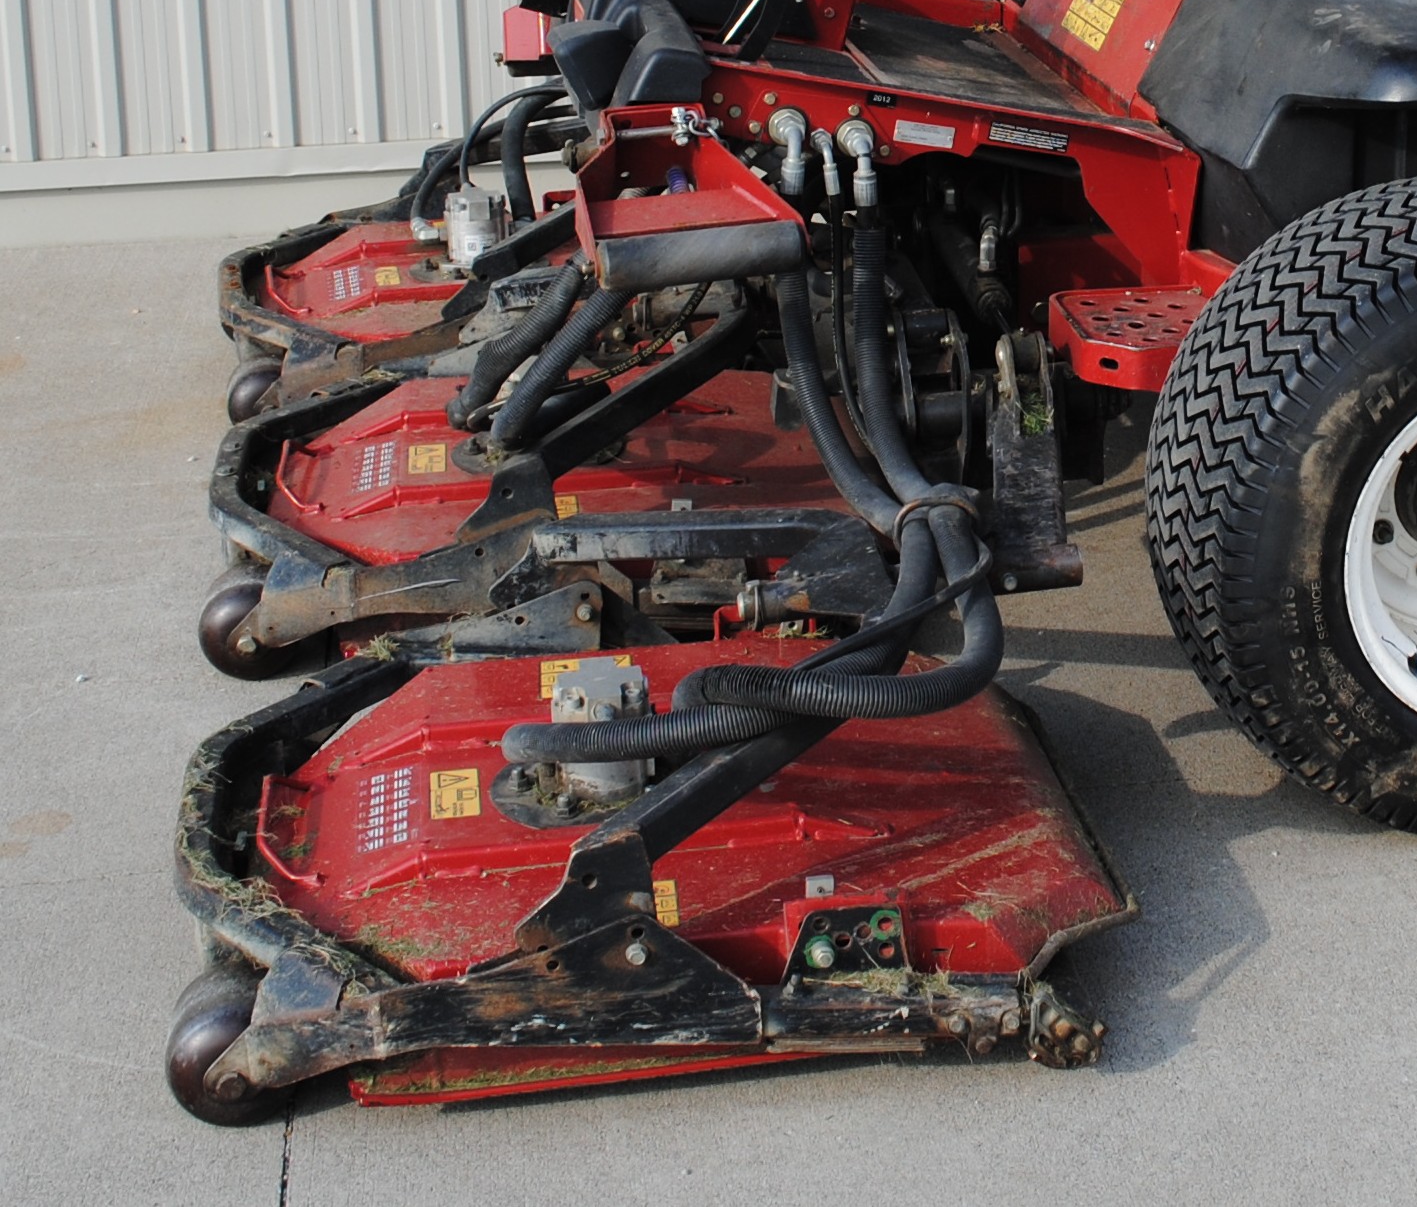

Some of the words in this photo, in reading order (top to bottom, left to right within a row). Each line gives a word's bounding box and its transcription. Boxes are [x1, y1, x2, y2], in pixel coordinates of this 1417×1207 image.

[872, 94, 892, 104] 2012
[1281, 585, 1301, 635] NHS
[1311, 580, 1329, 641] SERVICE
